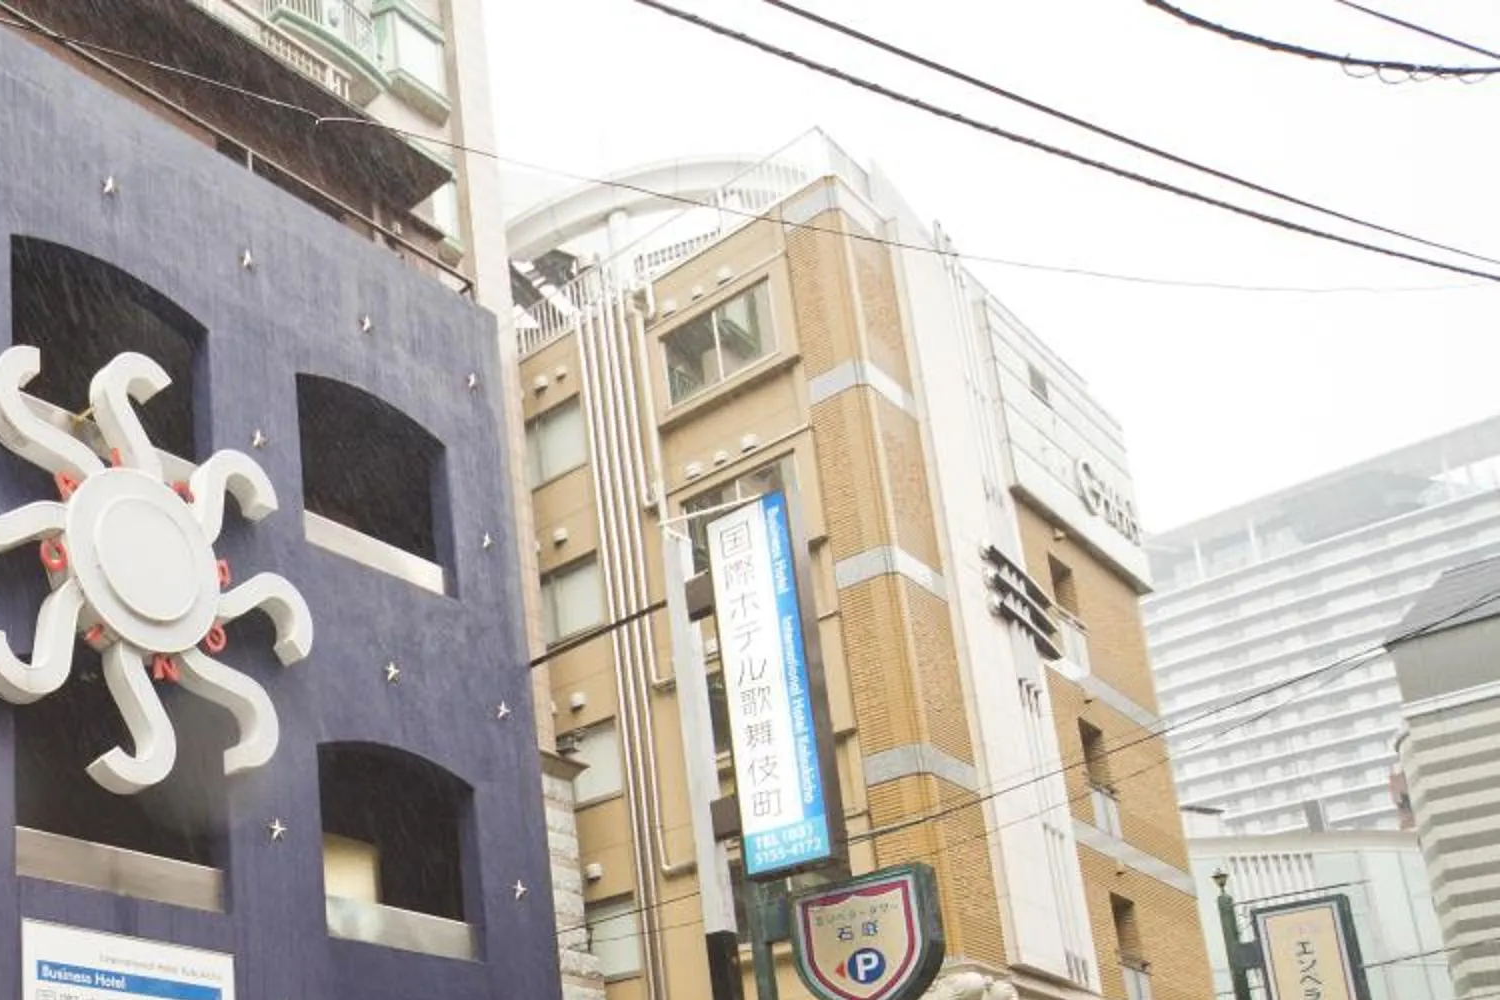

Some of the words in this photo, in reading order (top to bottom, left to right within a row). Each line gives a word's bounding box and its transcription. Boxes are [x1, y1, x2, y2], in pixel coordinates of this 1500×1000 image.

[718, 518, 783, 818] 国際ホテル歌舞伎町
[41, 965, 92, 986] Business
[95, 970, 126, 990] Hotel
[854, 953, 879, 981] P
